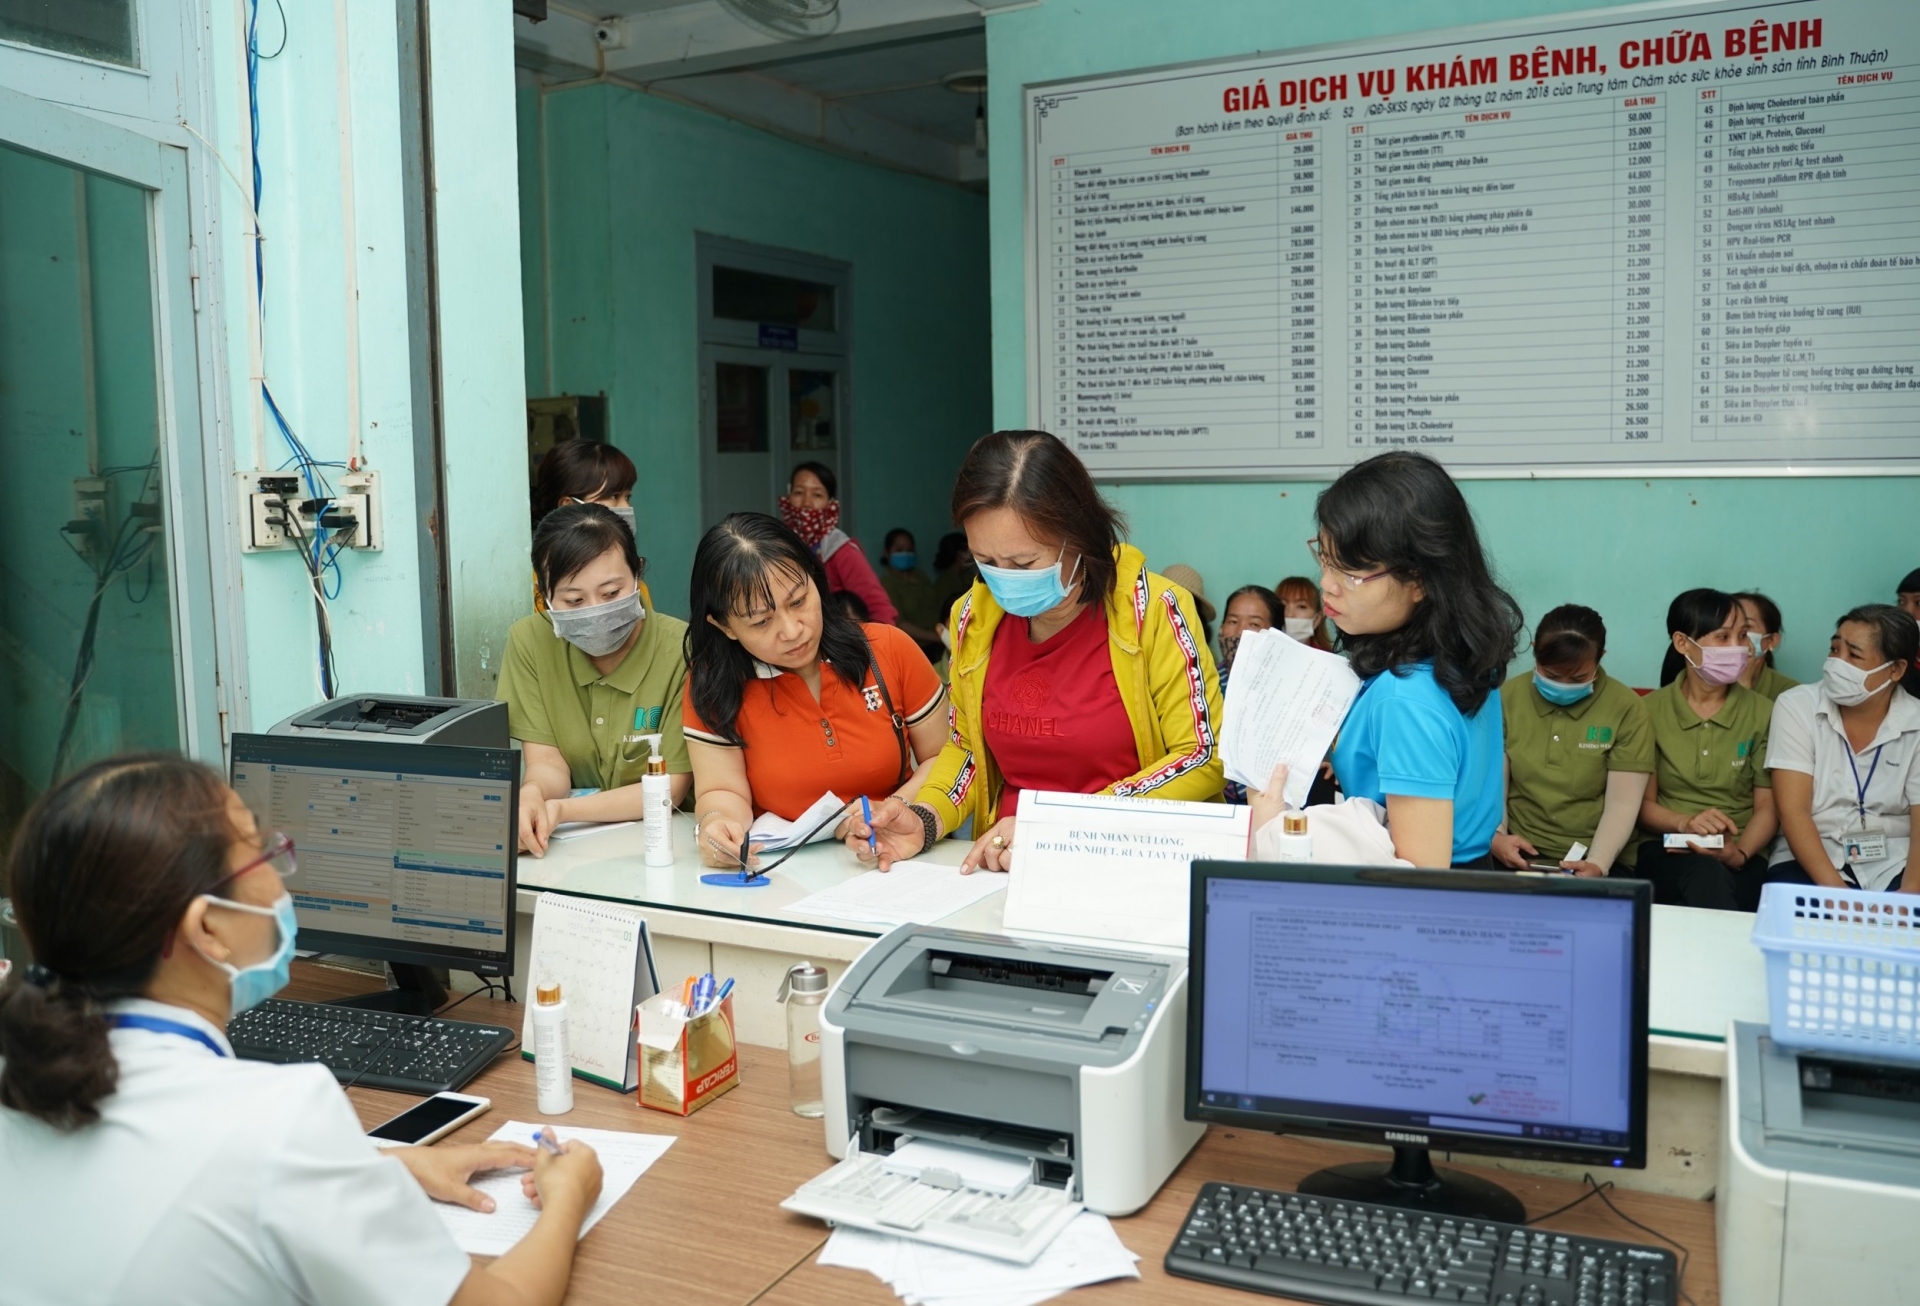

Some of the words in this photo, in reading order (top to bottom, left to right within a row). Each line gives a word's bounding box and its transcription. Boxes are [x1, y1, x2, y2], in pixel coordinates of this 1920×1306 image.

[1223, 79, 1270, 113] GIÁ
[1279, 74, 1347, 111] DỊCH
[1358, 67, 1396, 103] VỤ
[1406, 55, 1498, 92] KHÁM
[1510, 40, 1607, 84] BỆNH,
[1620, 29, 1712, 70] CHỮA
[1724, 18, 1824, 59] BỆNH
[1838, 75, 1854, 85] TÊN
[1857, 73, 1878, 83] DỊCH
[1881, 72, 1893, 81] VỤ
[1175, 125, 1194, 137] (Ban
[1197, 123, 1219, 134] hành
[1222, 121, 1241, 131] kèm
[1244, 118, 1263, 129] theo
[1266, 113, 1294, 126] Quyết
[1296, 108, 1316, 123] định
[1318, 109, 1332, 121] số:
[1343, 107, 1354, 118] 52
[1366, 101, 1408, 115] /QĐ-SKSS
[1411, 100, 1435, 113] ngày
[1439, 96, 1450, 108] 02
[1453, 94, 1482, 109] tháng
[1485, 91, 1496, 103] 02
[1500, 89, 1522, 102] năm
[1527, 83, 1549, 99] 2018
[1553, 82, 1572, 96] của
[1577, 80, 1604, 96] Trung
[1608, 78, 1628, 90] tâm
[1632, 74, 1664, 88] Chăm
[1668, 73, 1687, 84] sóc
[1691, 69, 1710, 82] sức
[1714, 64, 1742, 79] khỏe
[1746, 62, 1768, 76] sinh
[1772, 58, 1792, 73] sản
[1796, 55, 1817, 70] tỉnh
[1821, 54, 1845, 68] Bình
[1850, 49, 1889, 66] Thuận)
[1702, 90, 1716, 99] STT
[1624, 98, 1638, 107] GIÁ
[1641, 97, 1656, 105] THU
[1704, 105, 1713, 114] 45
[1465, 114, 1479, 122] TÊN
[1480, 113, 1499, 121] DỊCH
[1501, 111, 1511, 119] VỤ
[1628, 112, 1652, 122] 50.000
[1704, 120, 1713, 129] 46
[1351, 126, 1363, 134] STT
[1629, 126, 1652, 136] 35.000
[1629, 141, 1652, 151] 12.000
[1628, 156, 1651, 165] 12.000
[1628, 185, 1651, 194] 20.000
[987, 711, 1066, 738] CHANEL
[623, 930, 632, 942] 01
[696, 1059, 735, 1094] FERICAP
[1384, 1131, 1430, 1144] SAMSUNG
[1628, 1248, 1665, 1261] logitech
